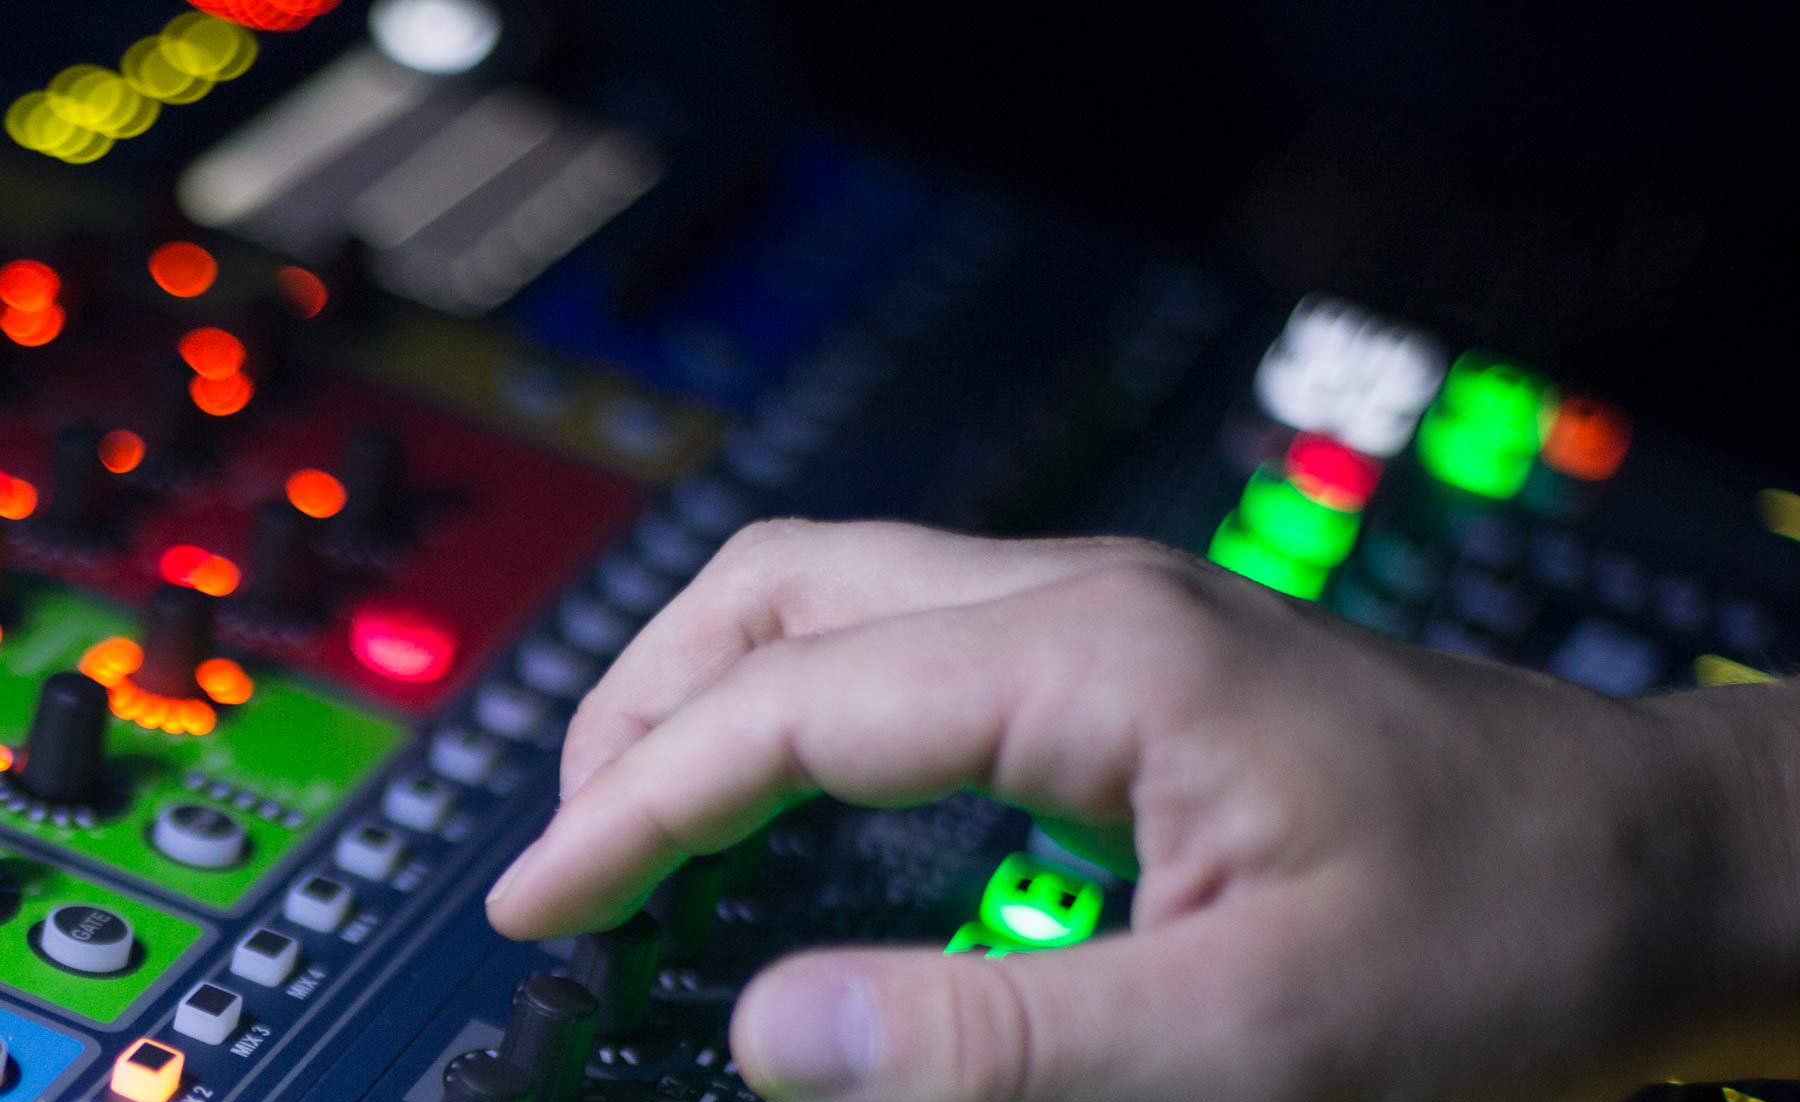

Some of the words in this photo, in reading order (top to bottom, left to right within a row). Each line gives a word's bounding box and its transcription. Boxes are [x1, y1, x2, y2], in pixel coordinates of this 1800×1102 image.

[71, 911, 111, 942] GATE
[286, 977, 318, 1000] MIX
[230, 1036, 262, 1058] MIX
[252, 1026, 271, 1037] 3
[193, 1085, 214, 1100] 2
